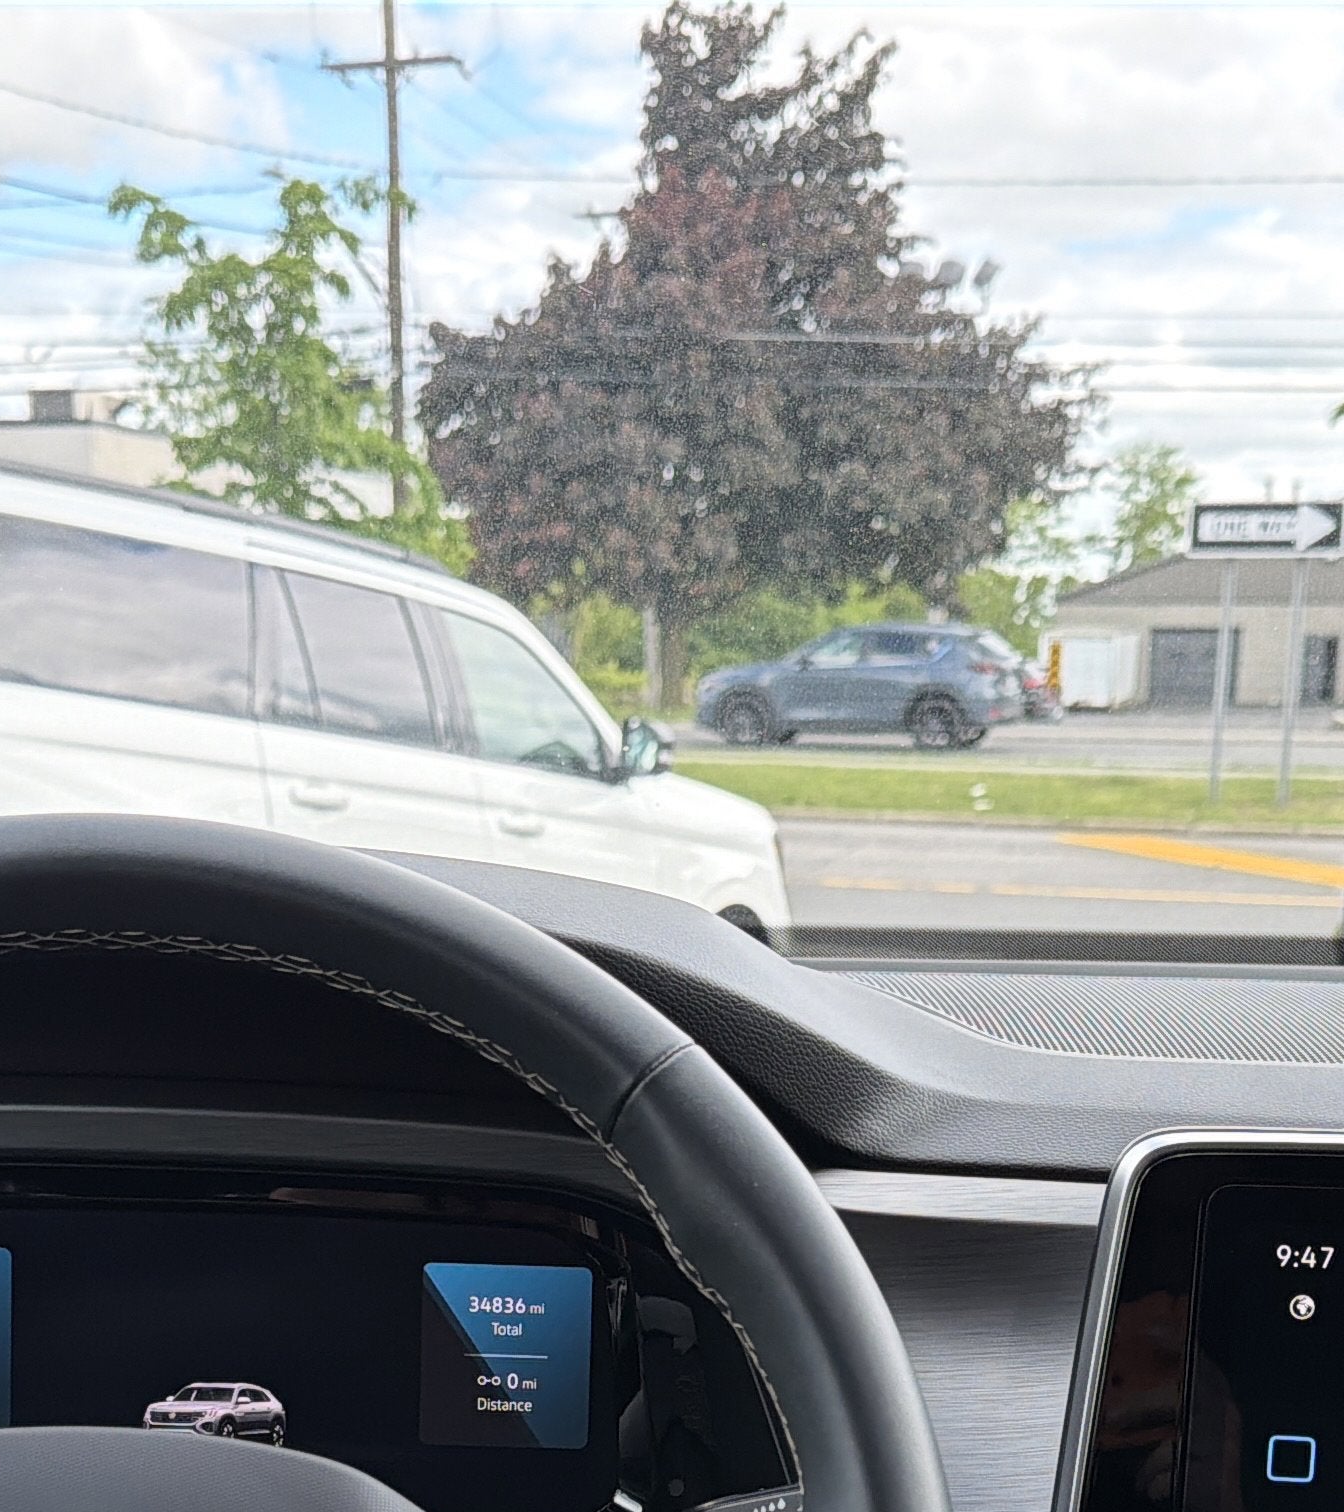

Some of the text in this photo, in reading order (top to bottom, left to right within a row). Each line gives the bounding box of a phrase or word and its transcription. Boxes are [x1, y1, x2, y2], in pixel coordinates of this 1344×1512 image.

[1277, 1245, 1334, 1268] 9:47
[469, 1296, 544, 1314] 34836 mi
[492, 1322, 522, 1336] Total
[507, 1373, 536, 1389] 0 mi
[478, 1398, 532, 1411] Distance
